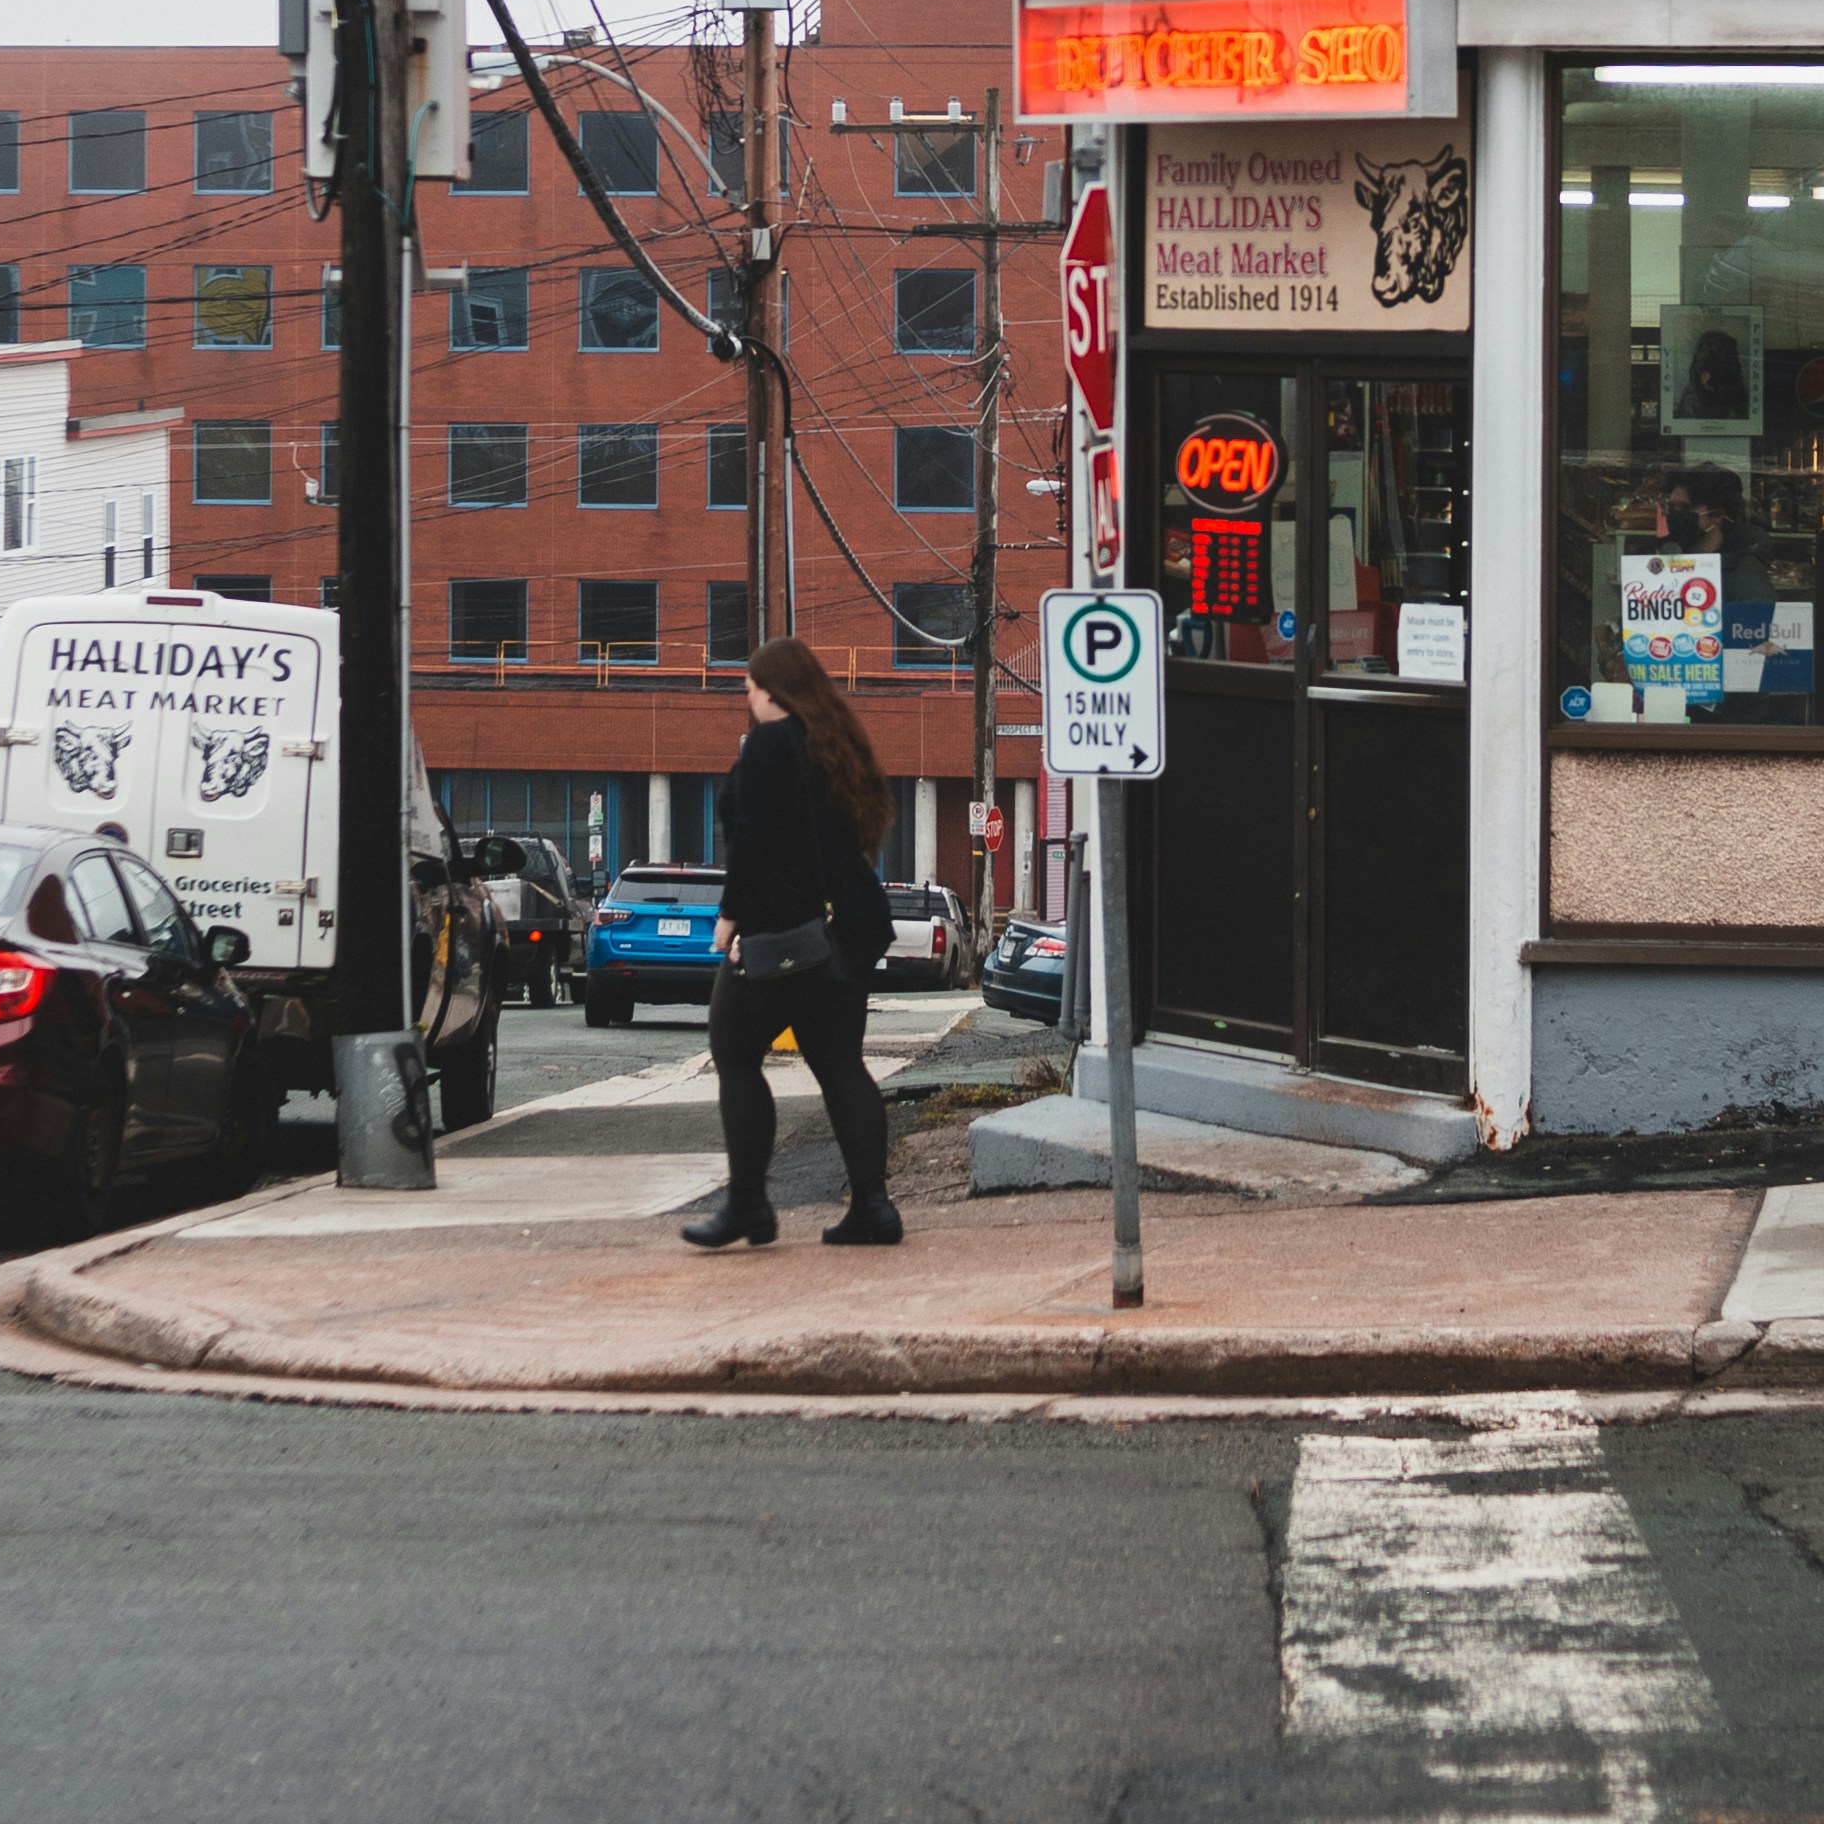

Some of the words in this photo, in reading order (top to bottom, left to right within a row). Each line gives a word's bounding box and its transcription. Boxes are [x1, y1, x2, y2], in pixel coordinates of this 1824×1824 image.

[1056, 31, 1282, 92] BUTCHER
[1295, 25, 1408, 86] SHO
[1156, 153, 1240, 192] Family
[1247, 153, 1342, 183] Owned
[1156, 195, 1323, 231] HALLIDAY'S
[1156, 243, 1222, 275] Meat
[1231, 243, 1328, 276] Market
[1068, 265, 1108, 357] ST
[1156, 284, 1279, 312] Established
[1289, 285, 1339, 312] 1914
[1178, 437, 1273, 493] OPEN
[1628, 598, 1684, 621] BINGO
[1732, 623, 1765, 639] Red
[1769, 623, 1801, 639] Bull
[50, 638, 292, 682] HALLIDAY'S
[1628, 663, 1646, 681] ON
[1650, 663, 1682, 682] SALE
[1685, 663, 1720, 682] HERE
[48, 688, 137, 710] MEAT
[150, 692, 286, 717] MARKET
[1065, 691, 1086, 715] 15
[1091, 691, 1131, 715] MIN
[1069, 722, 1127, 747] ONLY
[986, 820, 1002, 839] STOP
[175, 876, 272, 895] Groceries
